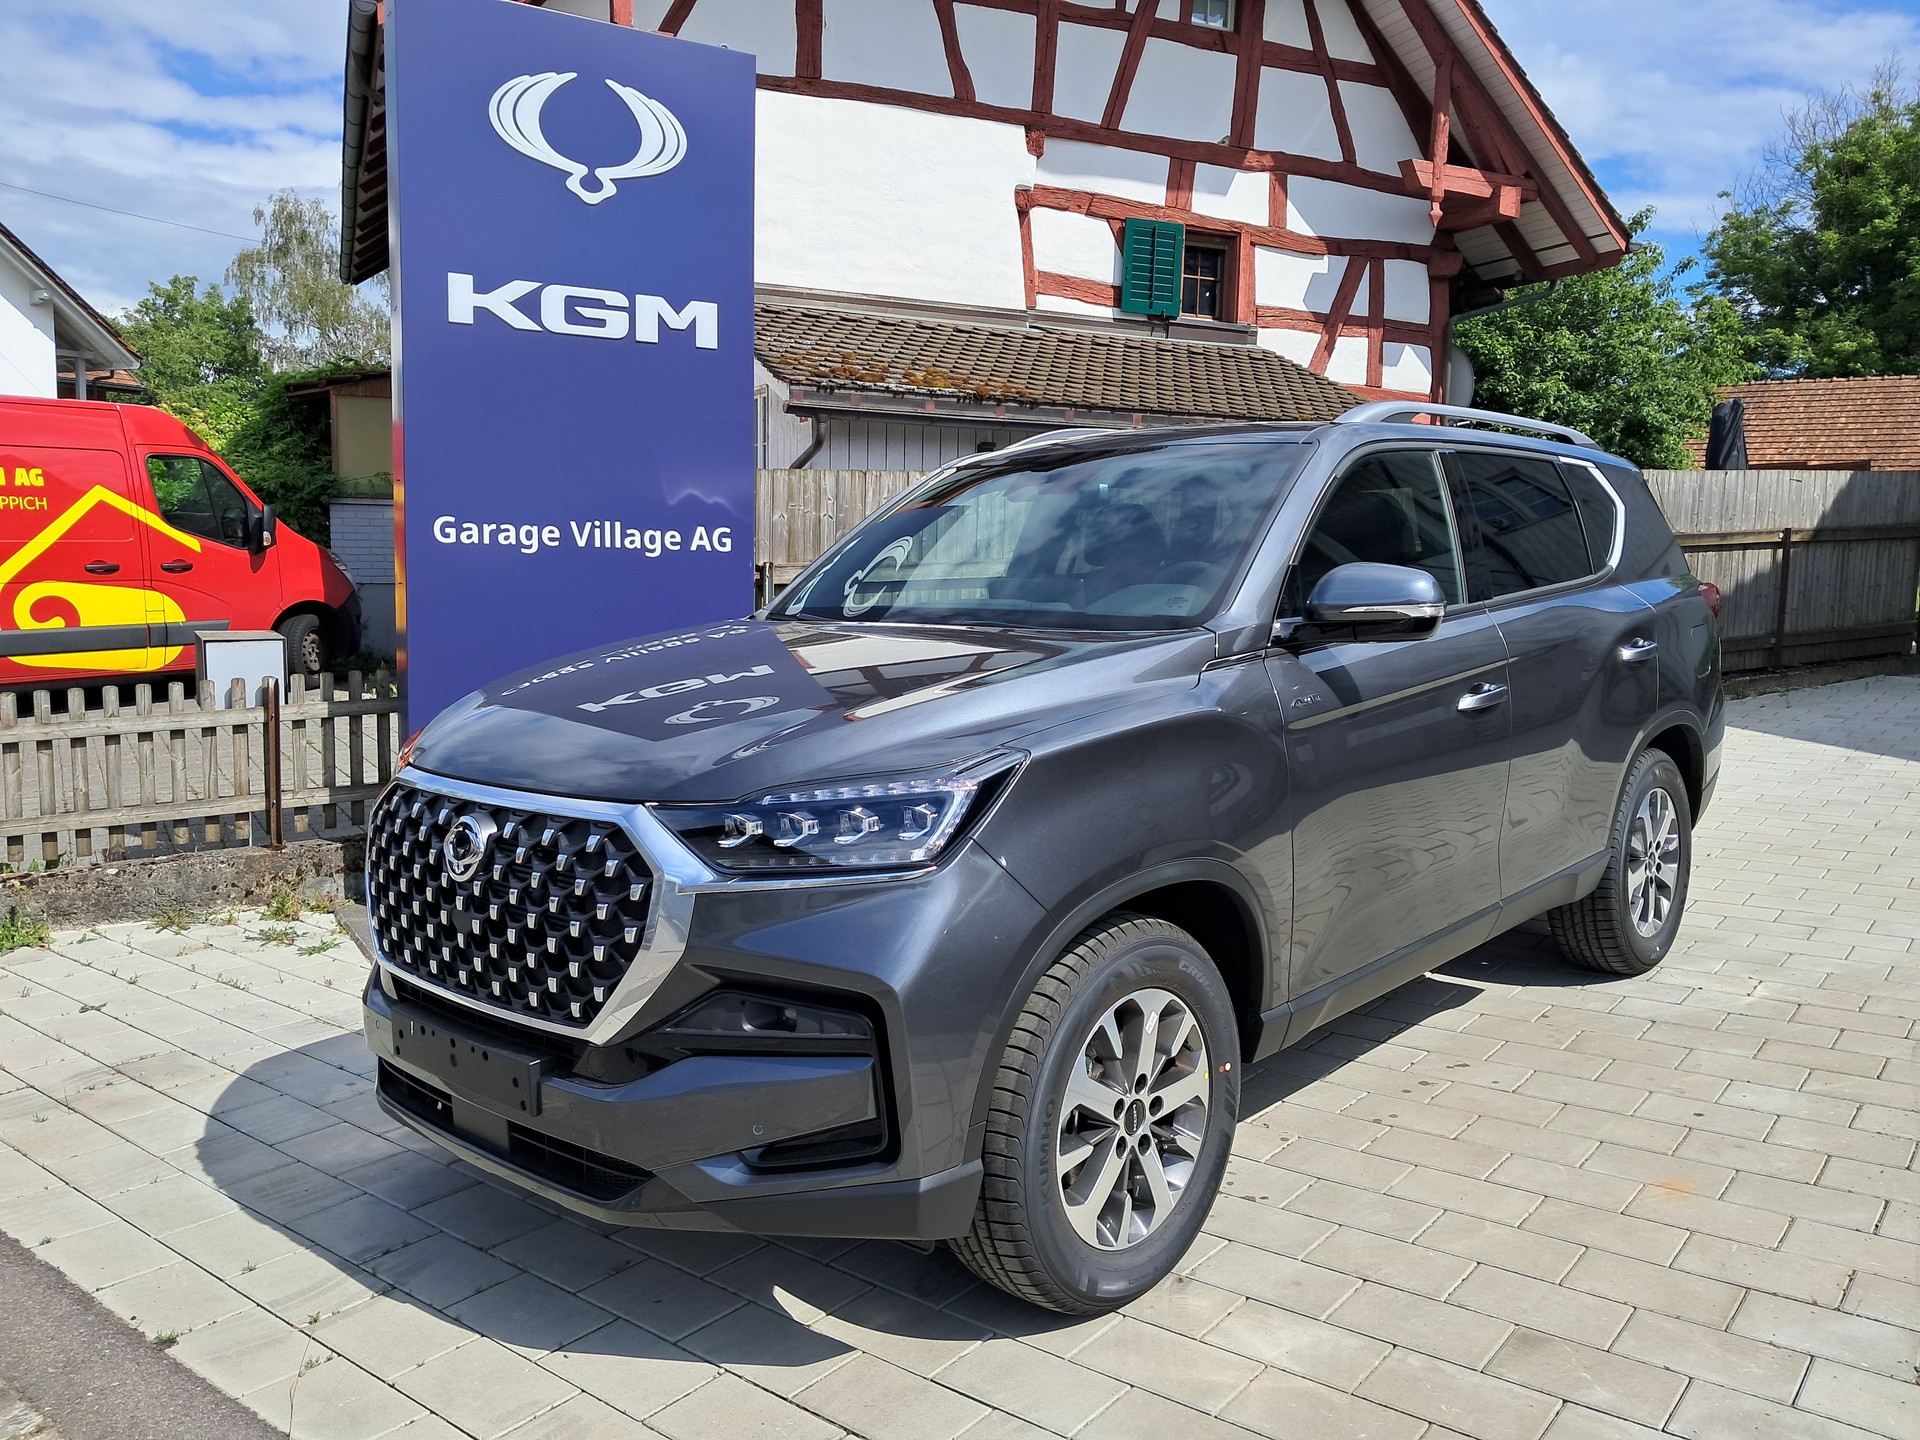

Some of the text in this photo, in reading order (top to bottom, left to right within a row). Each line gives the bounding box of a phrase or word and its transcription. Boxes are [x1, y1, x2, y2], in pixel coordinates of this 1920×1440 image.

[447, 271, 718, 350] KGM
[14, 467, 45, 486] AG
[433, 515, 732, 558] Garage Village AG
[1039, 1099, 1056, 1208] KUMHO
